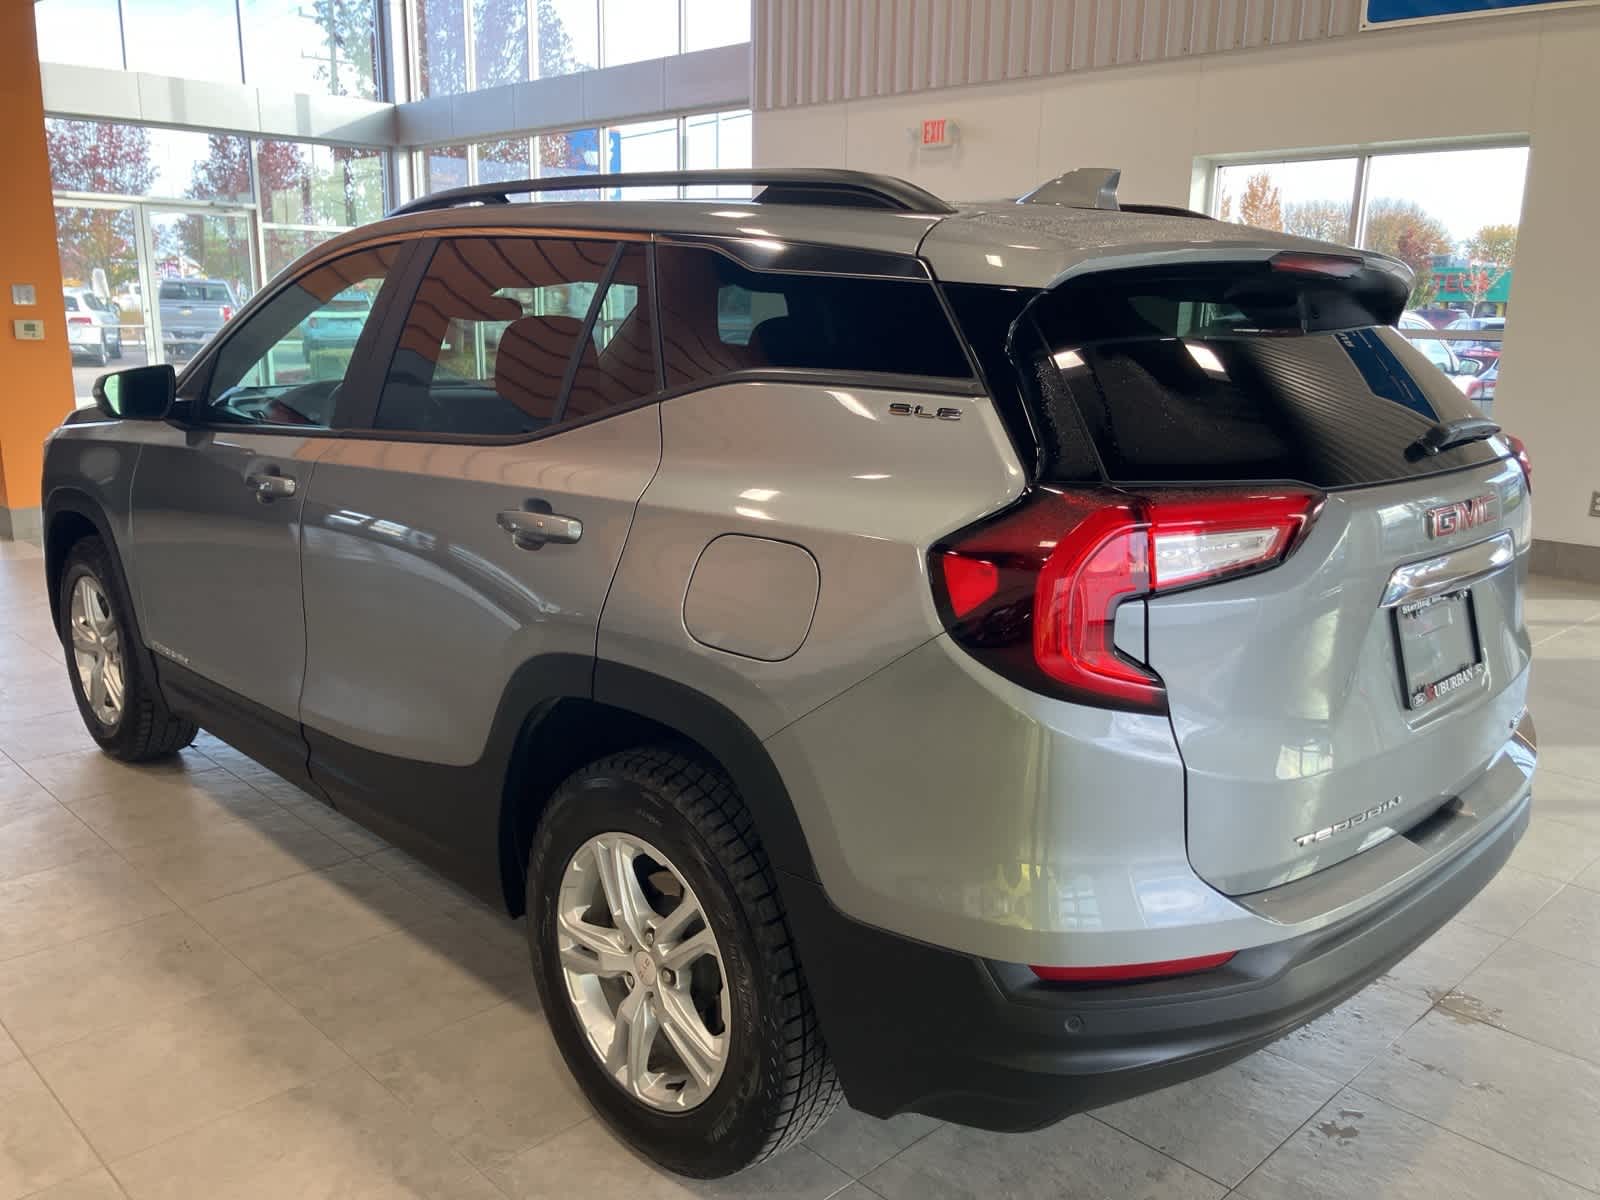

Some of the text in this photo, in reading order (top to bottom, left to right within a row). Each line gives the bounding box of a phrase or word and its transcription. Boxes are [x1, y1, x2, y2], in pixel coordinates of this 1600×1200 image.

[922, 119, 945, 145] EXIT
[887, 402, 962, 421] SLE
[1429, 494, 1497, 537] GMC
[1294, 795, 1402, 846] TERRAIN
